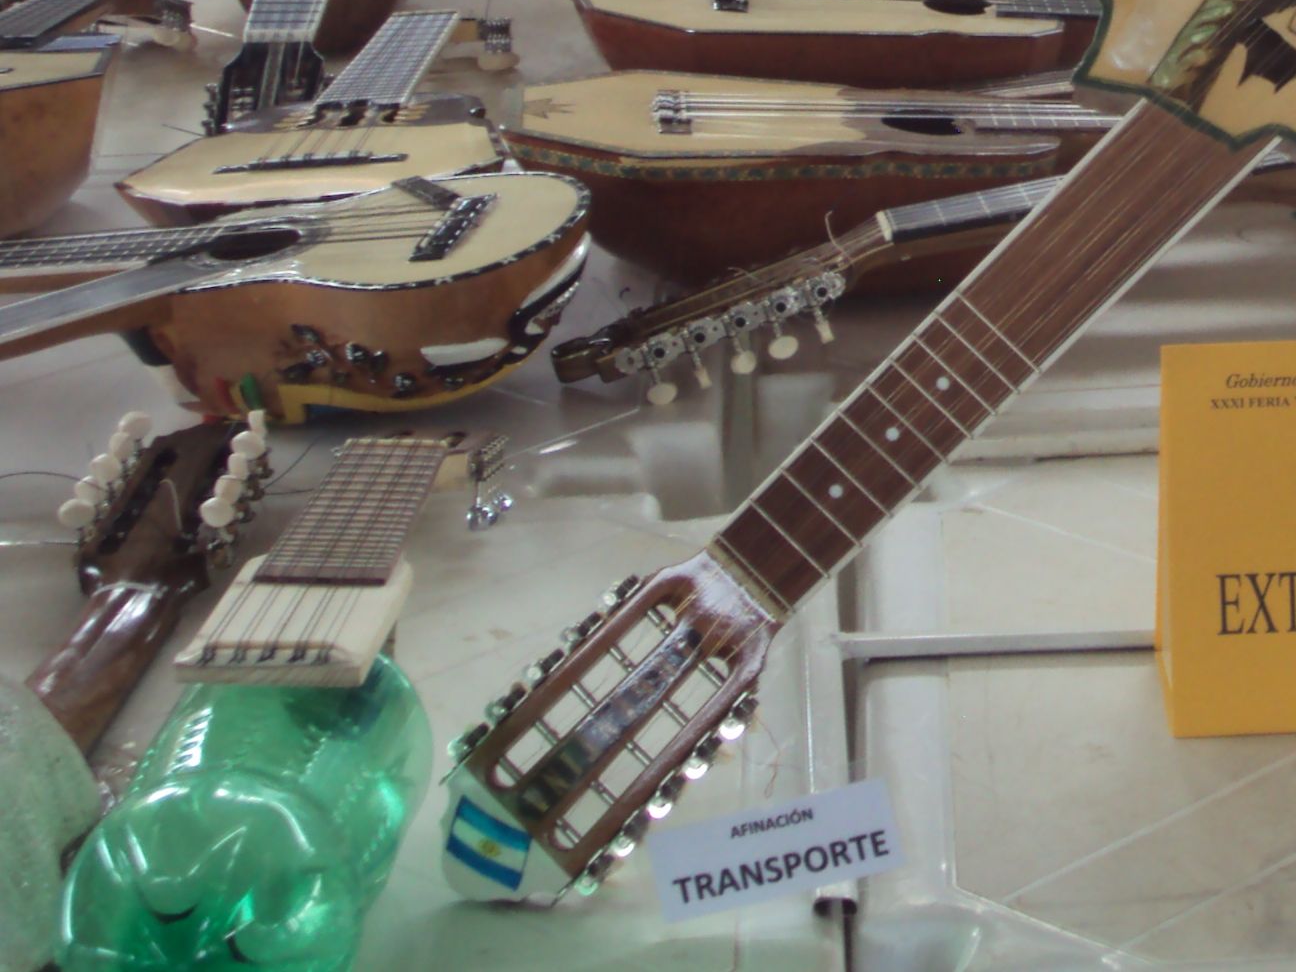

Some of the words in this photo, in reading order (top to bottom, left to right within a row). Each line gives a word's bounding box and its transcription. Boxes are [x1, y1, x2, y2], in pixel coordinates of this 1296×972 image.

[1210, 397, 1244, 410] XXXI
[1249, 396, 1291, 409] FERIA
[729, 808, 815, 839] AFINACIÓN
[672, 830, 890, 904] TRANSPORTE
